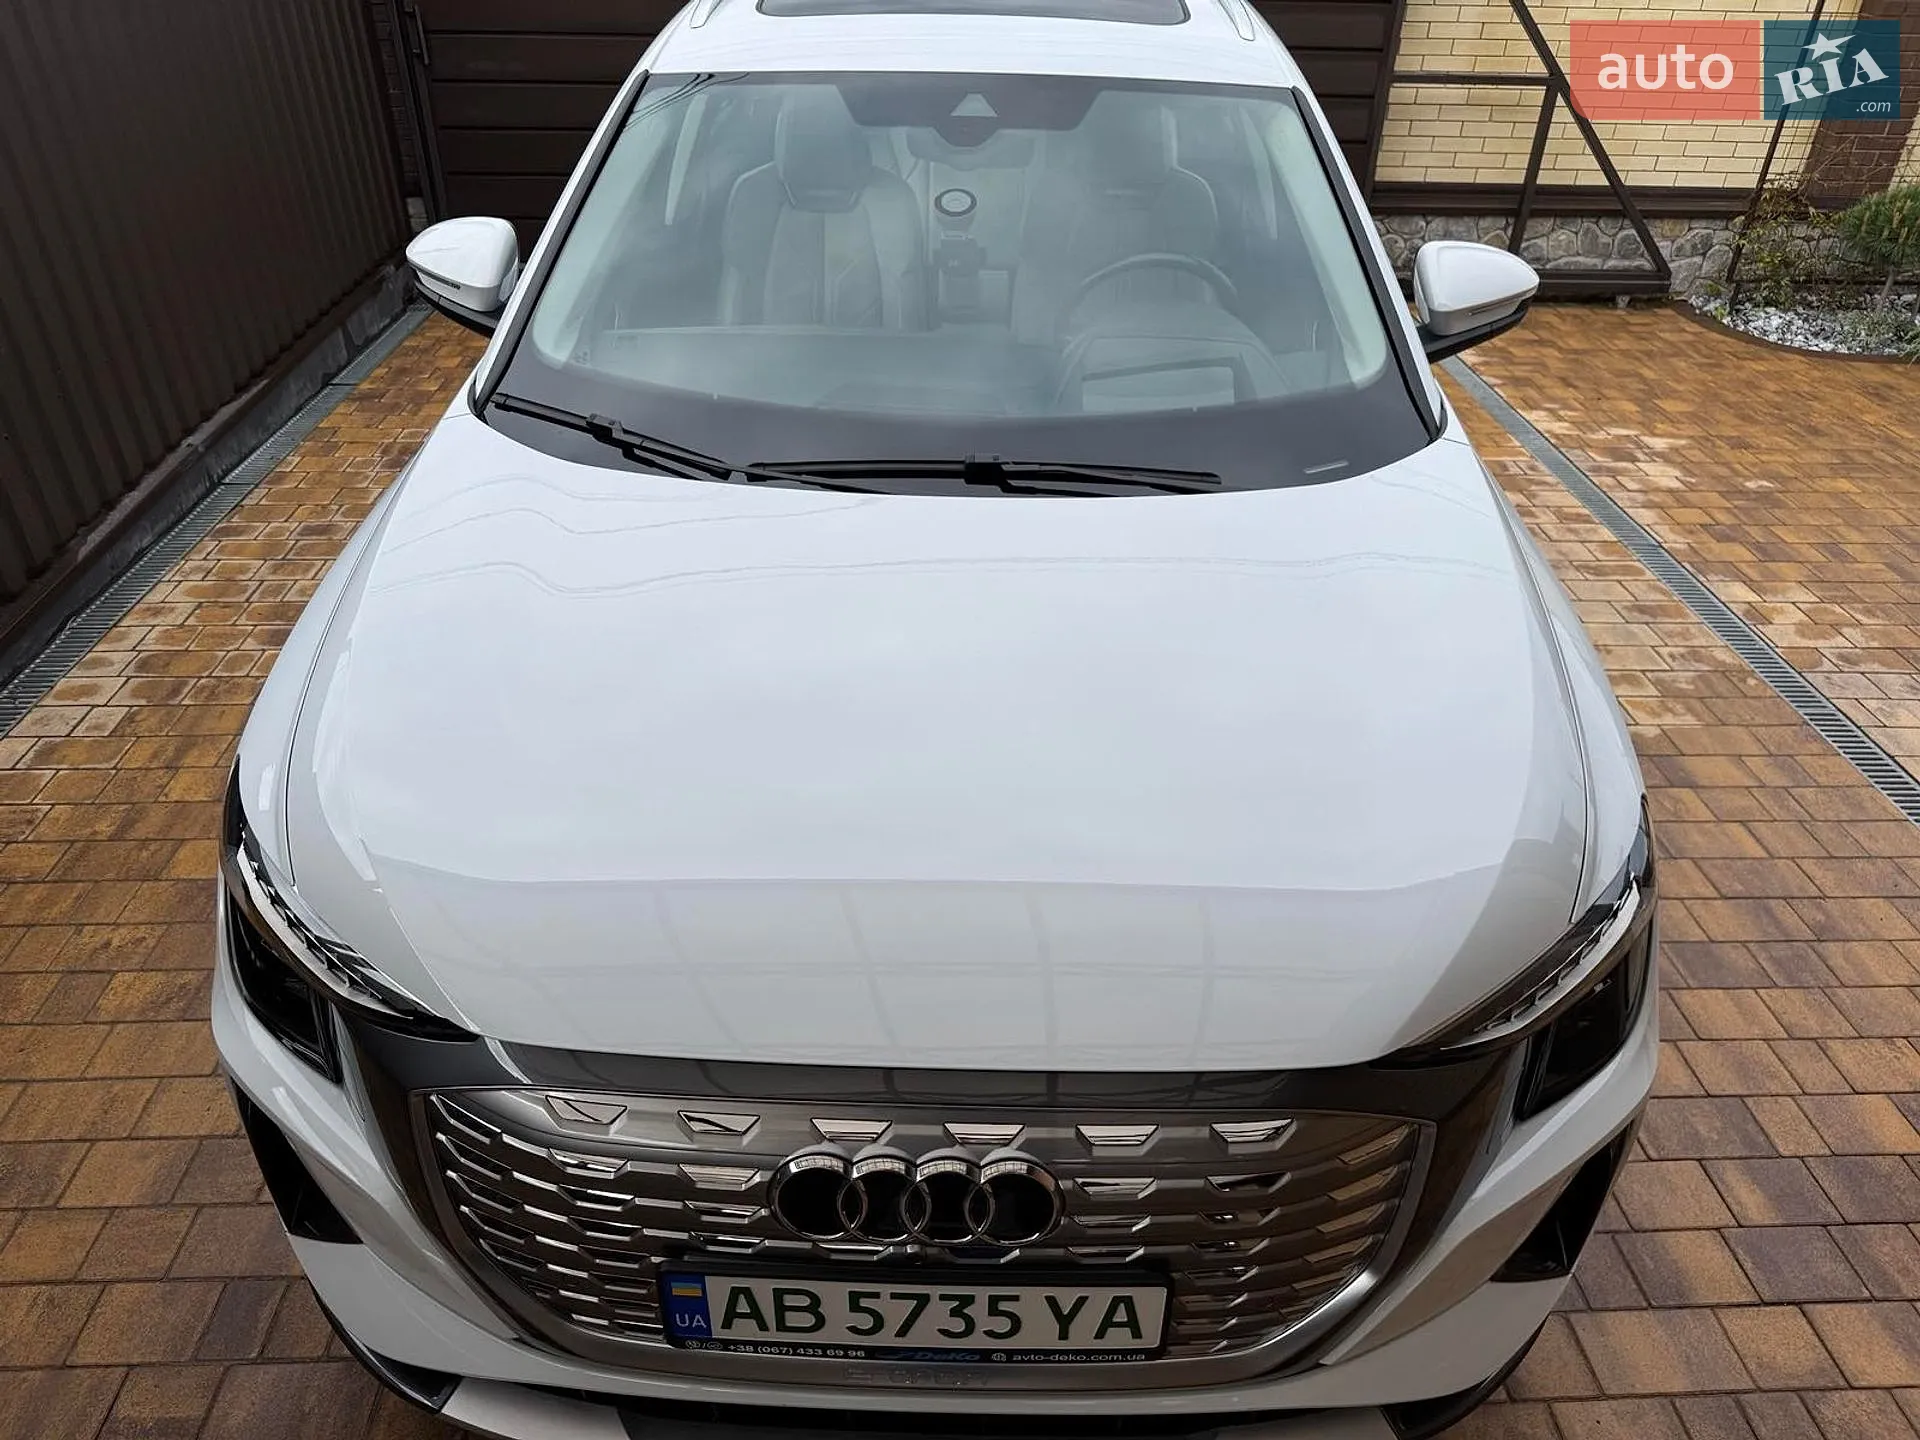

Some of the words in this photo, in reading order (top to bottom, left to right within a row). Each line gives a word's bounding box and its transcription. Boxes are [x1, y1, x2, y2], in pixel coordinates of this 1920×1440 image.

[675, 1313, 707, 1329] UA
[720, 1286, 826, 1334] AB
[845, 1290, 1022, 1340] 5735
[1044, 1295, 1143, 1341] YA
[727, 1344, 754, 1354] +38
[758, 1345, 793, 1356] (067)
[796, 1347, 823, 1357] 433
[826, 1349, 844, 1357] 69
[847, 1350, 866, 1358] 96
[1012, 1352, 1146, 1362] avto-deko.com.ua
